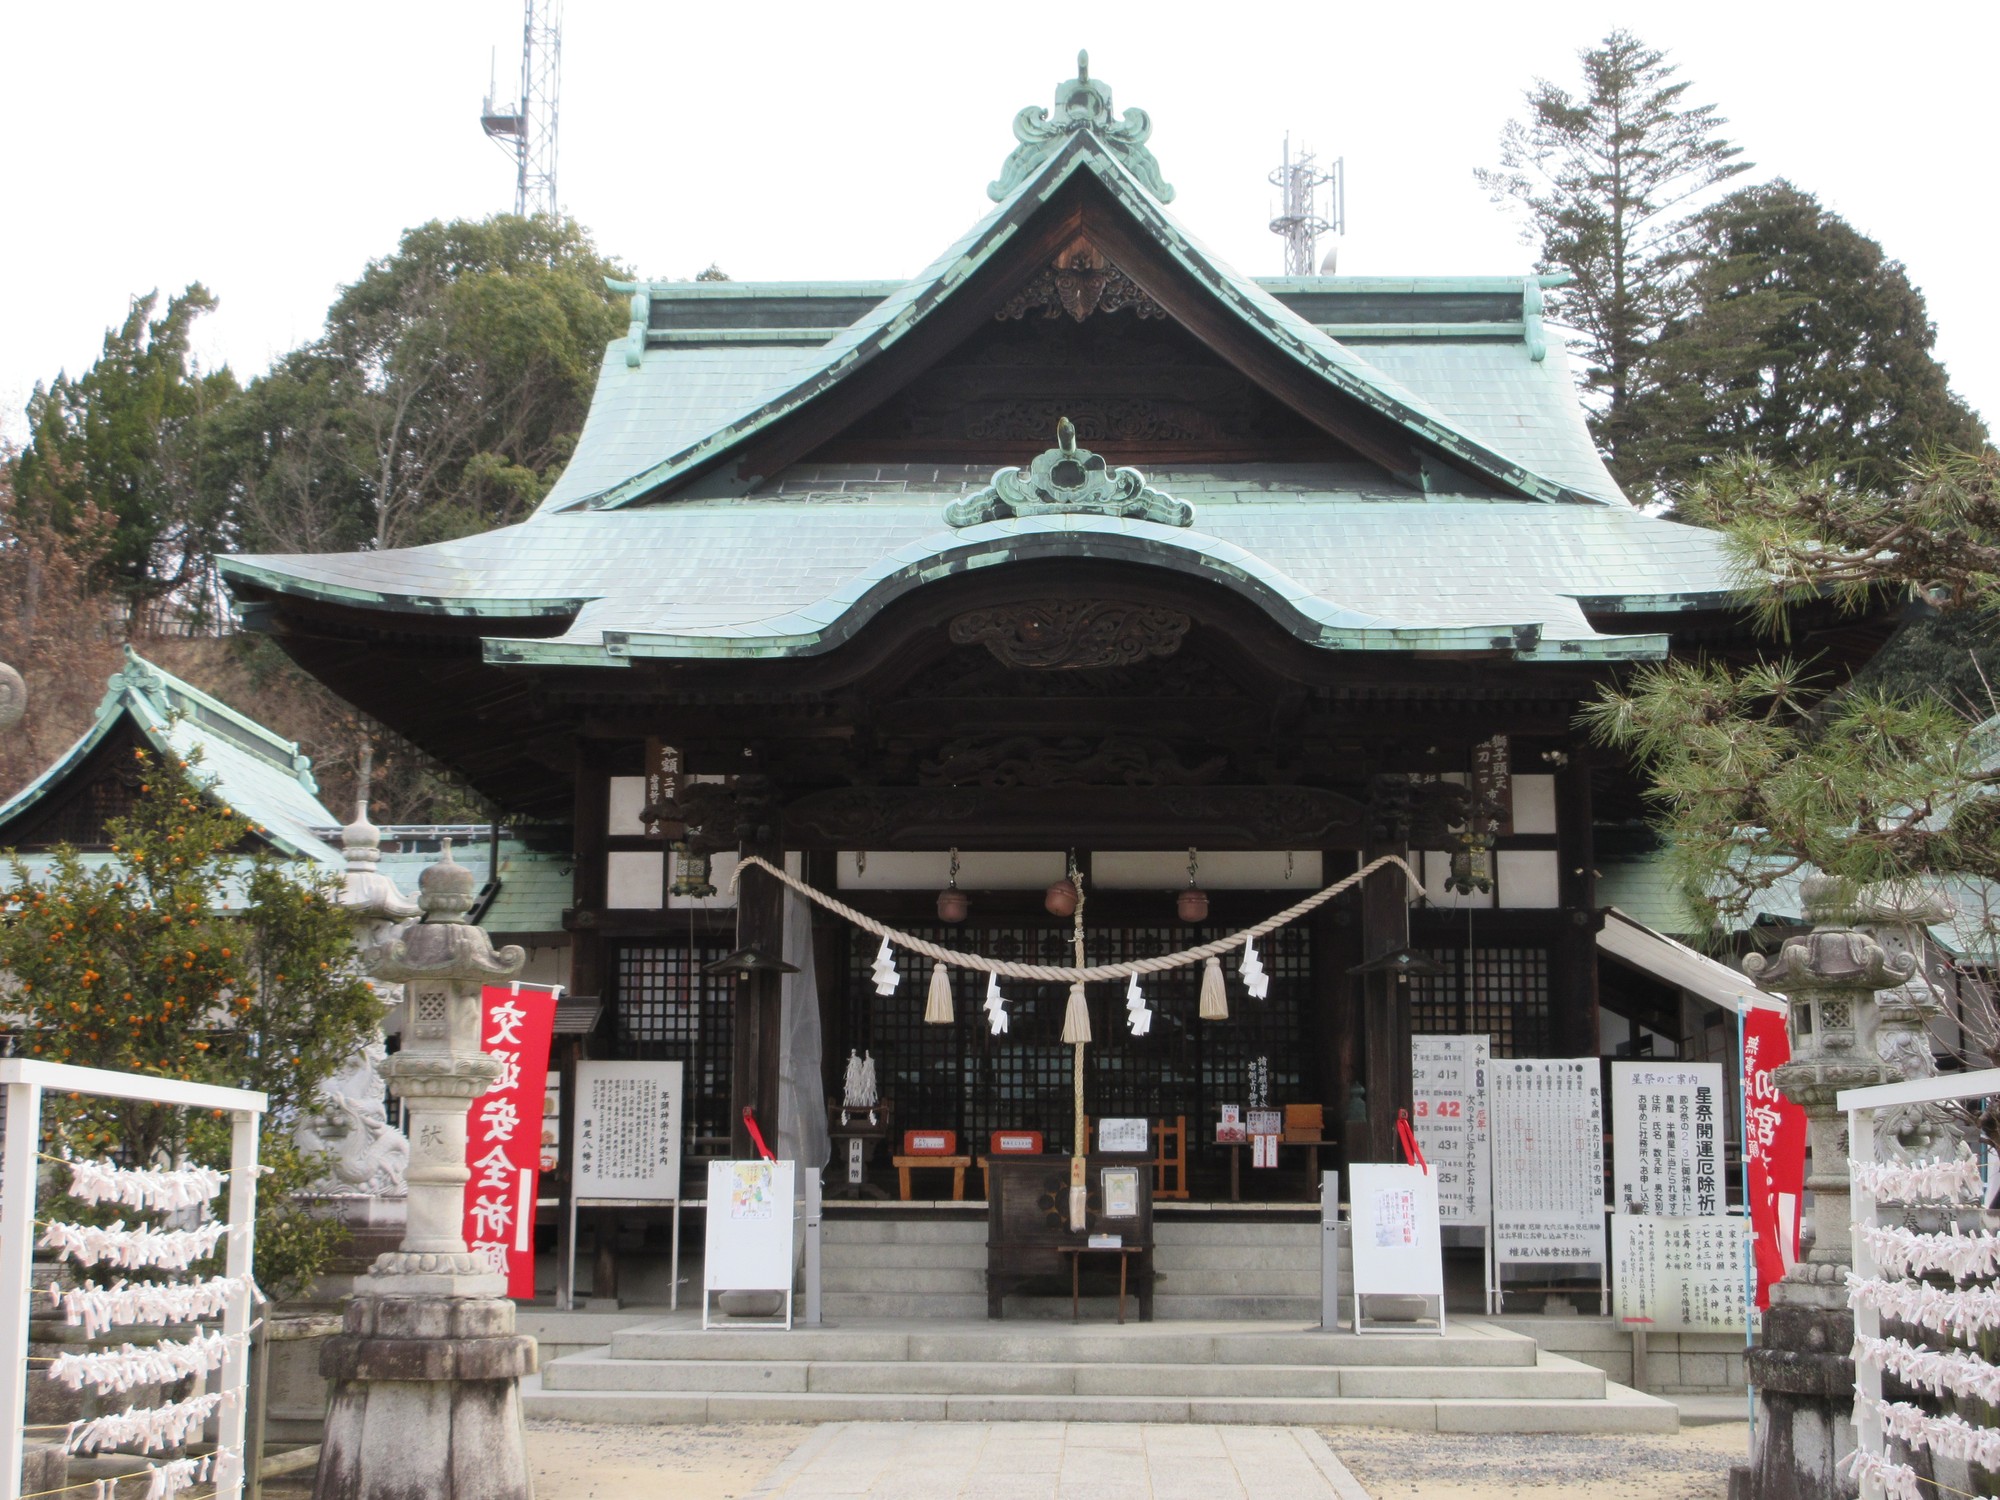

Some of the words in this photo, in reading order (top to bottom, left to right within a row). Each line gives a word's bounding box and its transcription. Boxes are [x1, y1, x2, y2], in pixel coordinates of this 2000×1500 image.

[1631, 1073, 1698, 1085] 星祭のご案内
[1413, 1101, 1429, 1117] 3
[1436, 1101, 1461, 1117] 42
[1637, 1094, 1650, 1216] お早めに社務所へお申し込み
[1695, 1087, 1716, 1217] 星祭開運厄除祈
[1508, 1247, 1592, 1258] 椎尾八幡宮社務所
